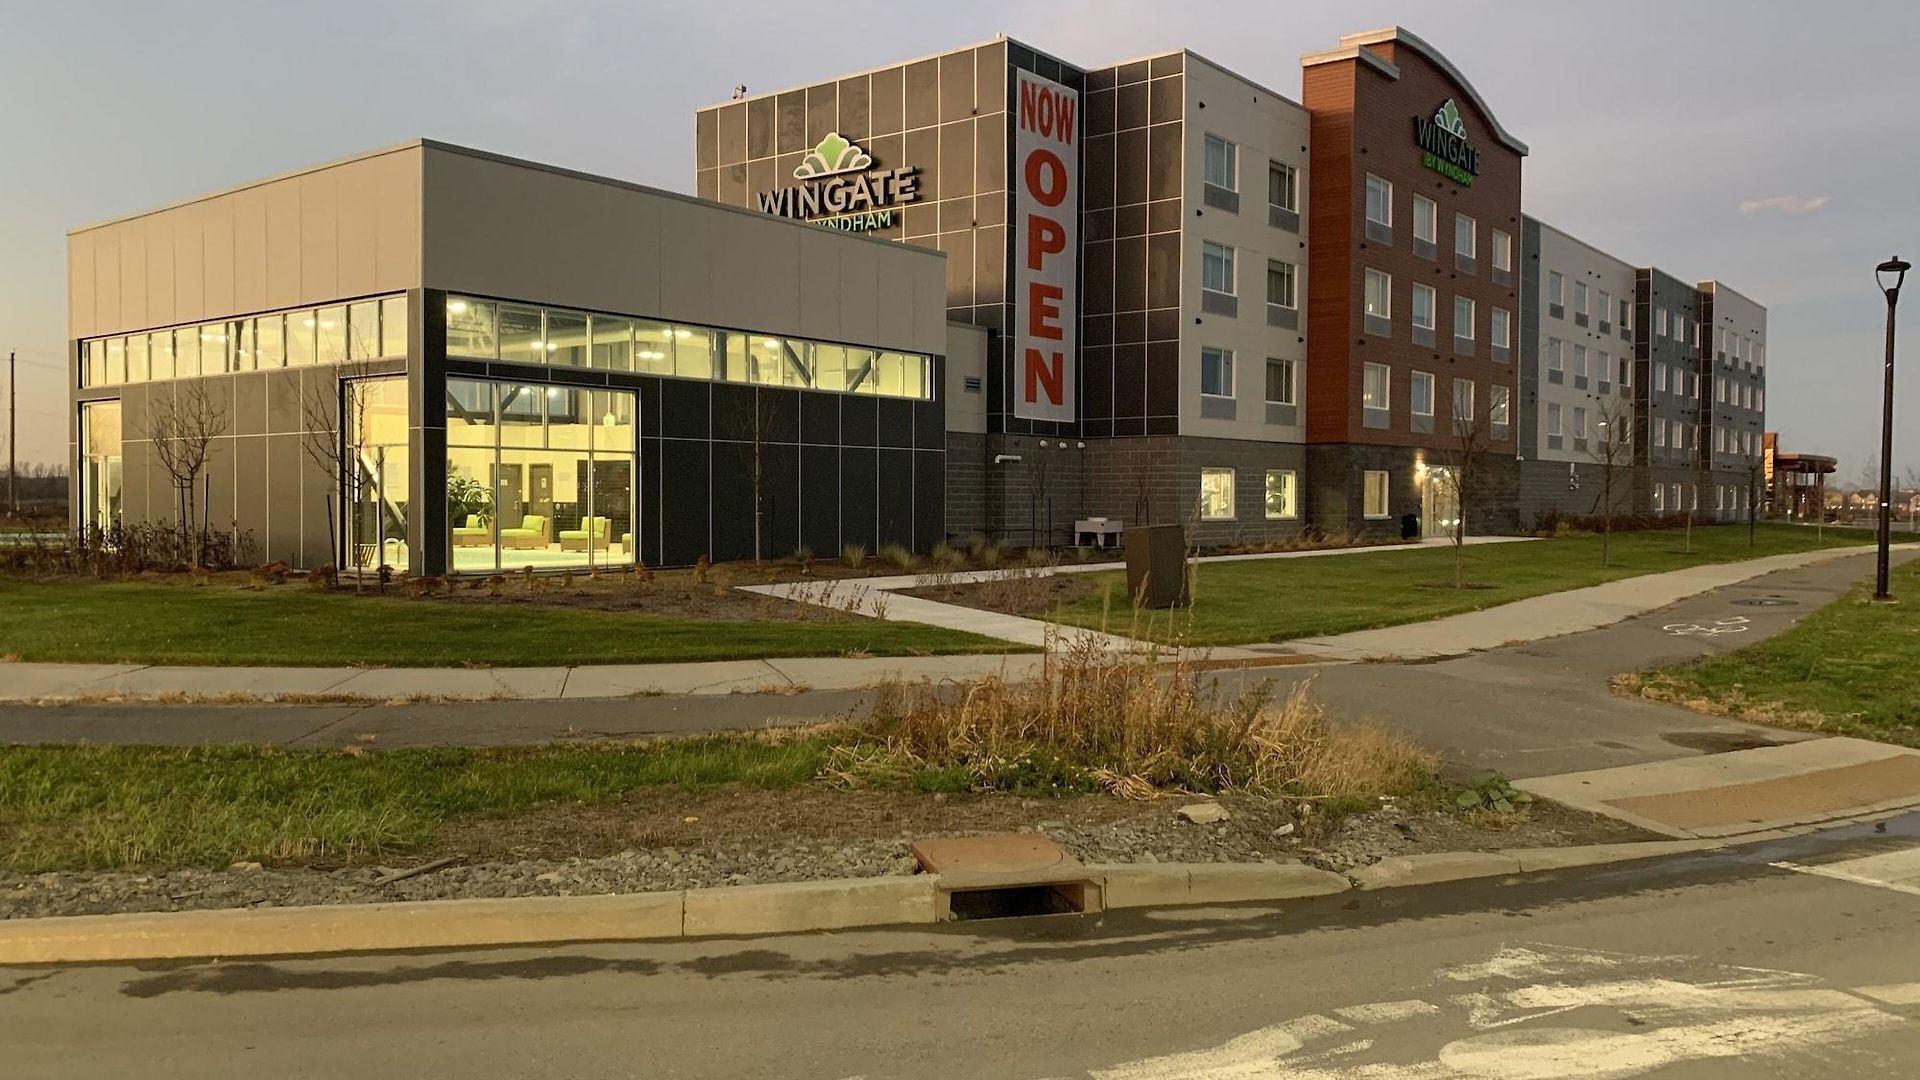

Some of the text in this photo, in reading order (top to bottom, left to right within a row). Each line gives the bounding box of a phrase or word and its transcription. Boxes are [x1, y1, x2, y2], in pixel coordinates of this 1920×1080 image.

[1020, 79, 1075, 145] NOW
[1417, 115, 1479, 176] WINGATE
[756, 165, 915, 218] WINGATE
[814, 210, 891, 231] NDHAM
[1024, 149, 1068, 406] OPEN
